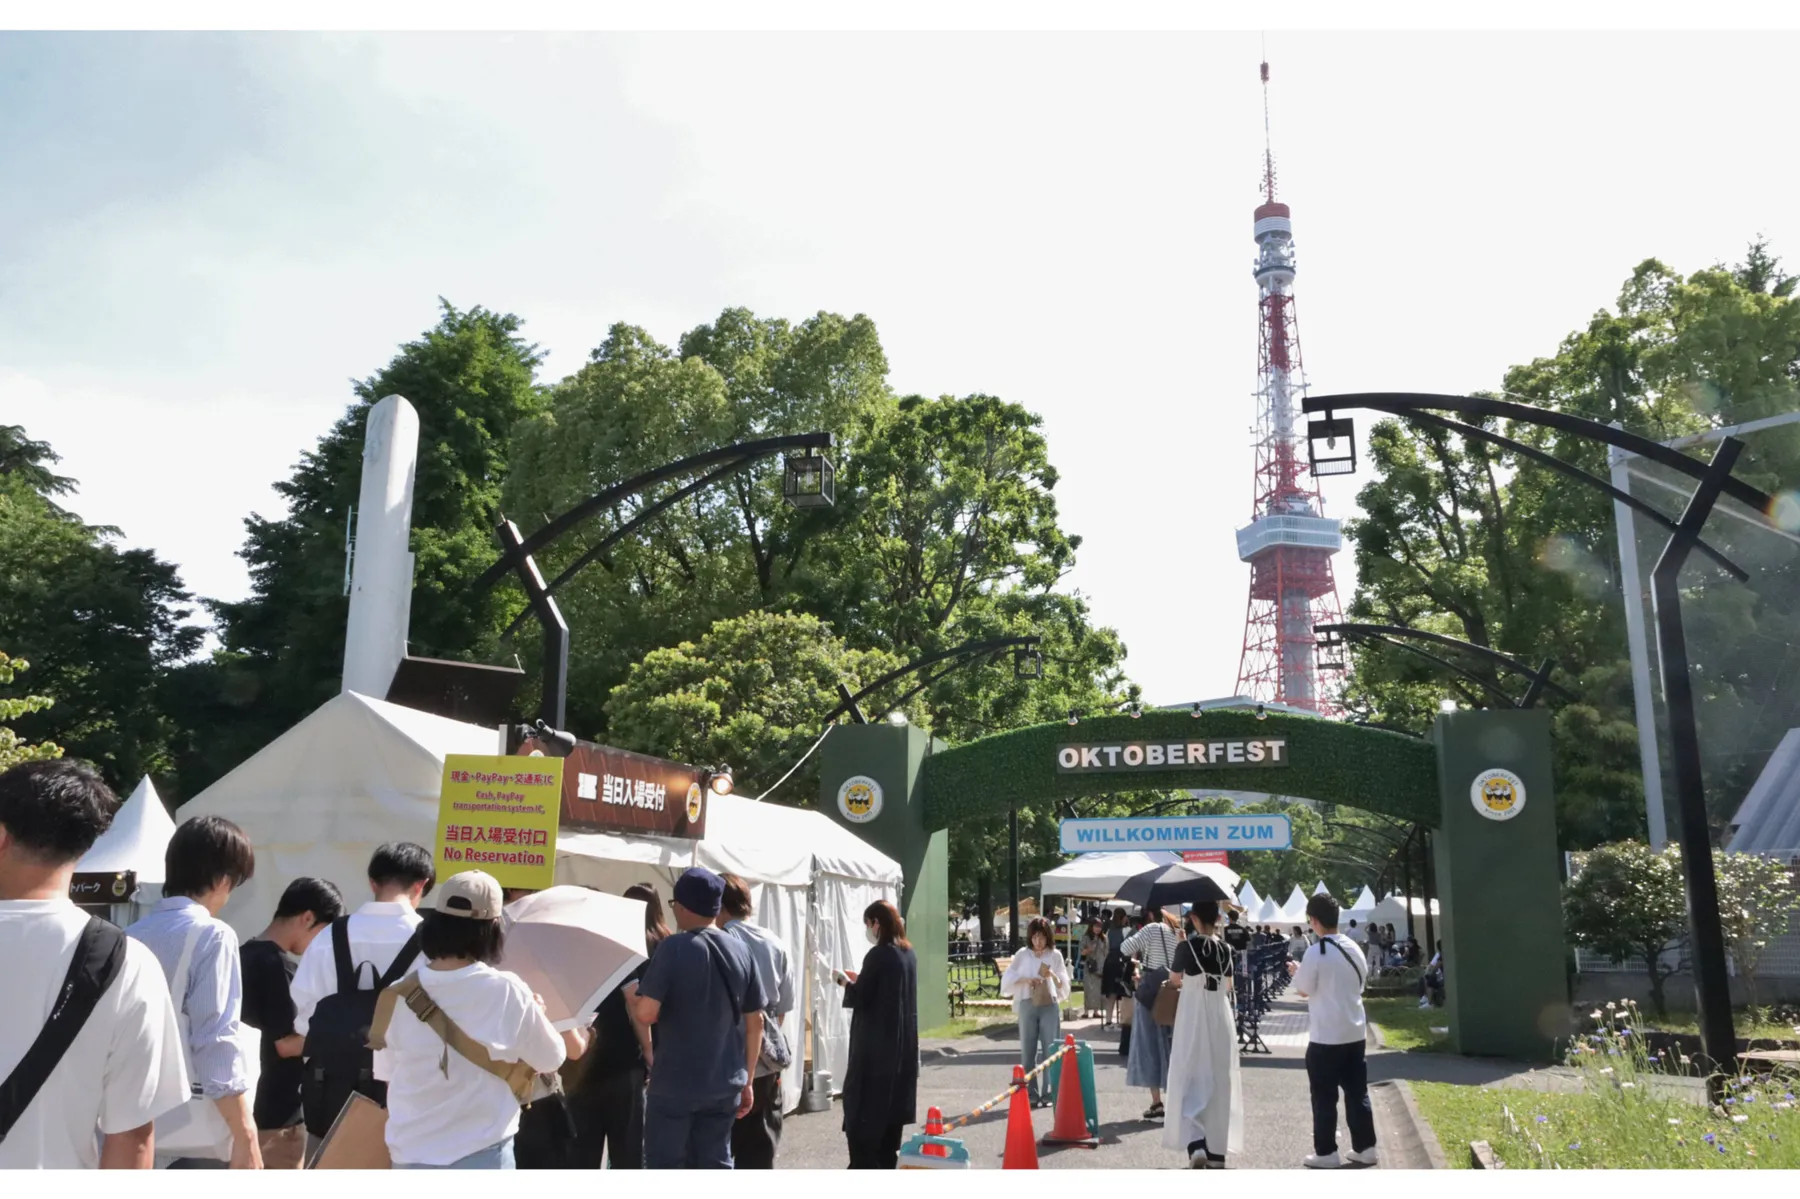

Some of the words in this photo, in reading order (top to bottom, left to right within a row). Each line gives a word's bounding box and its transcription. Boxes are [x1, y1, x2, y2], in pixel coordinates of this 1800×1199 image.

[1058, 740, 1285, 769] OKTOBERFEST
[475, 790, 496, 801] Cash,
[496, 791, 525, 803] PayPay
[601, 773, 666, 811] 当日入場受付
[453, 801, 507, 813] transportation
[507, 803, 534, 814] system
[445, 824, 549, 846] 当日入場受付口
[1076, 826, 1219, 843] WILLKOMMEN
[1227, 825, 1274, 840] ZUM
[443, 846, 462, 861] No
[464, 847, 546, 866] Reservation
